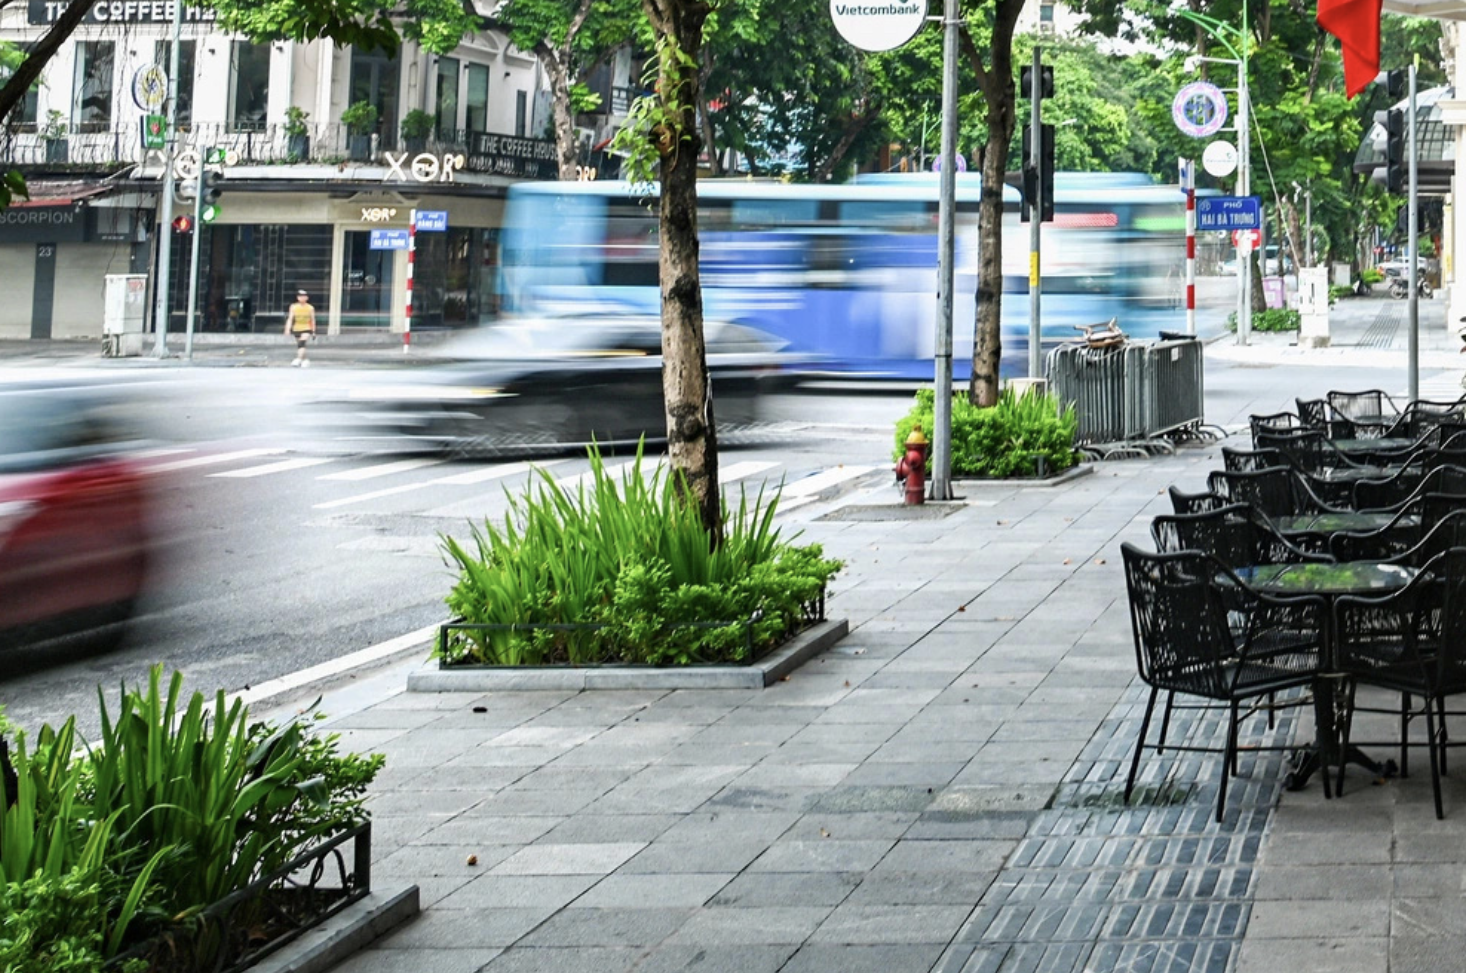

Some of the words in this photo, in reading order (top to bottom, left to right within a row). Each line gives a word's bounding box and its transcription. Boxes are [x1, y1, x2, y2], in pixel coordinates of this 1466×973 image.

[93, 1, 175, 21] COFFEE
[835, 3, 921, 16] Vietcombank
[480, 135, 499, 154] THE
[500, 137, 533, 158] COFFEE
[1201, 213, 1215, 225] HAI
[1217, 211, 1228, 225] BÀ
